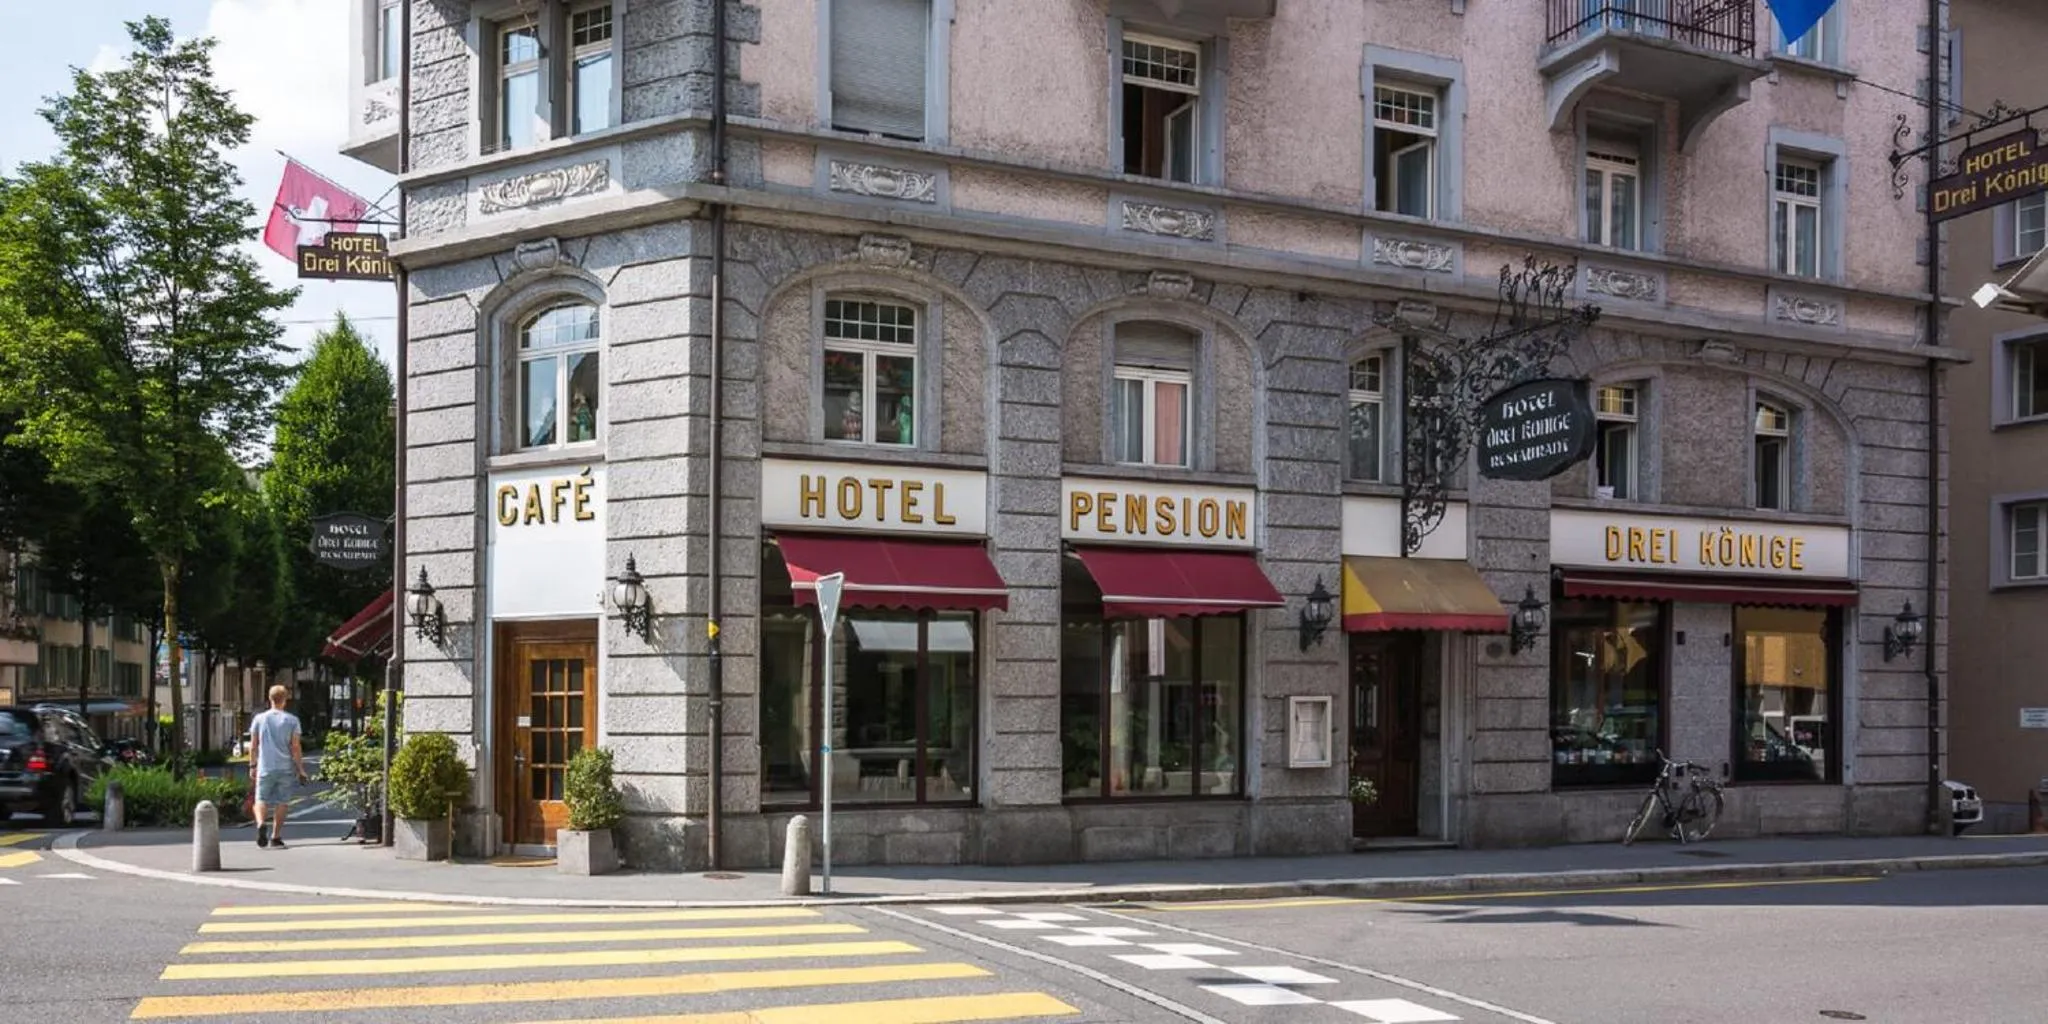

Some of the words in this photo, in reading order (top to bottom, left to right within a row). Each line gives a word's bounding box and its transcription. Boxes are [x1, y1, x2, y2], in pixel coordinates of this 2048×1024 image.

[1966, 140, 2031, 175] HOTEL
[1934, 181, 1977, 213] Drei
[304, 253, 339, 272] Drei
[331, 238, 381, 252] HOTEL
[1502, 390, 1557, 420] HOTEL
[497, 465, 595, 527] CAFÉ
[799, 474, 956, 526] HOTEL
[1069, 490, 1248, 540] PENSION
[1605, 525, 1678, 563] DREI
[1699, 525, 1806, 571] KÖNIGE
